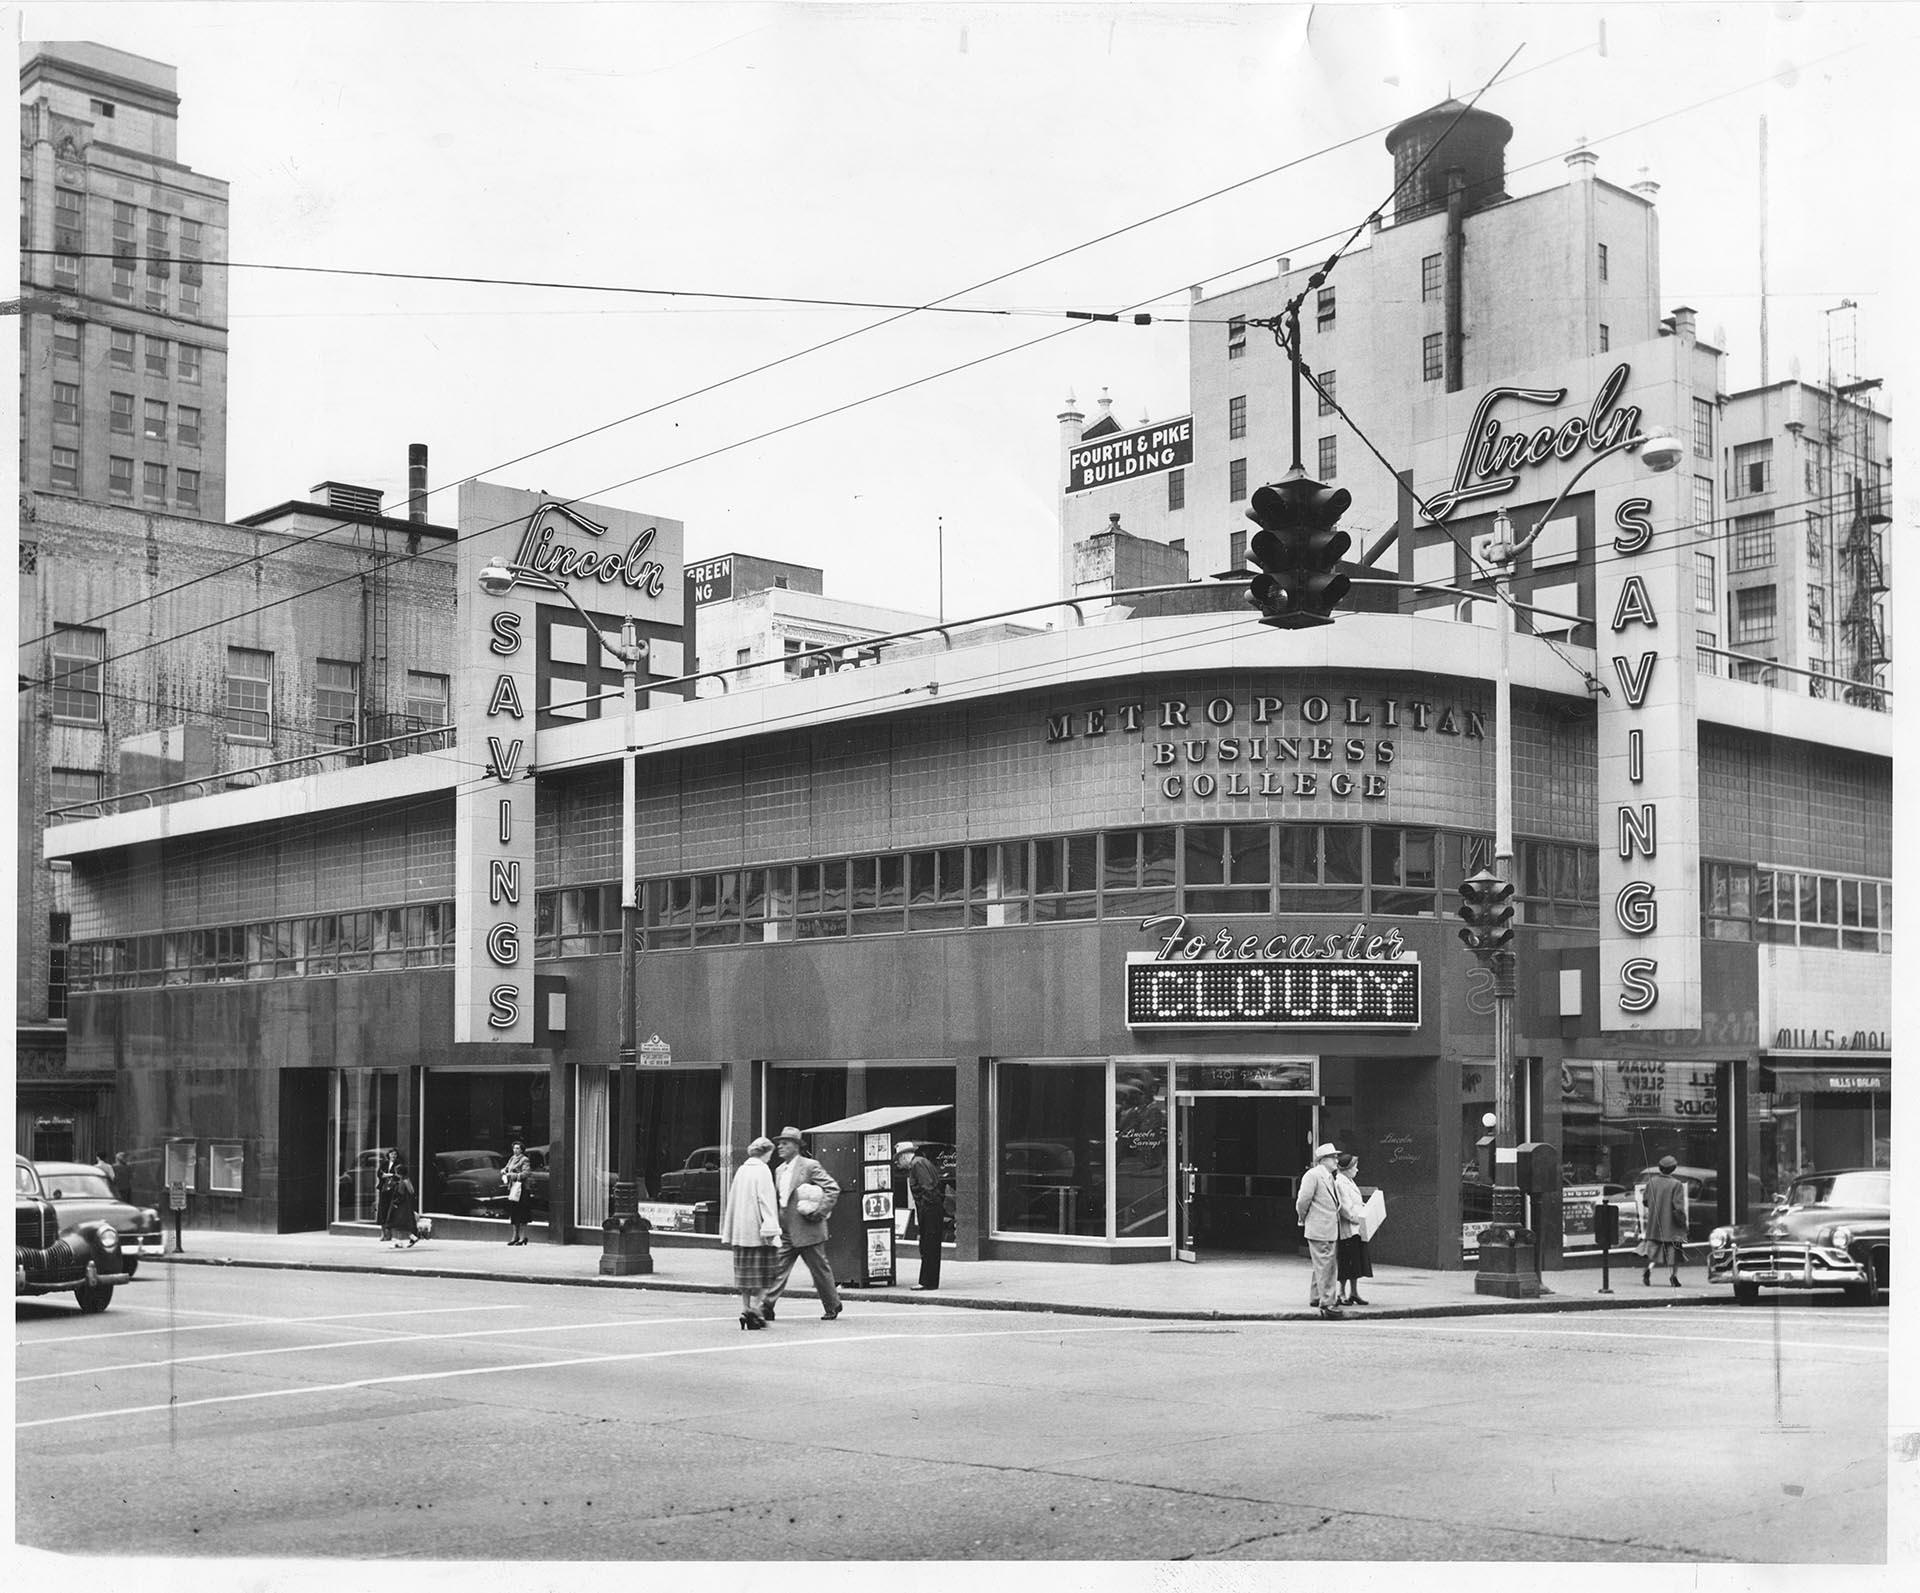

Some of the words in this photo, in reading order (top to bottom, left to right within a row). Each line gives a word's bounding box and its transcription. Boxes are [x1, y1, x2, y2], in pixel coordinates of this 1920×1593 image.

[1071, 439, 1133, 471] FOURTH
[1136, 435, 1148, 453] &
[1152, 423, 1190, 449] PIKE
[1083, 447, 1176, 486] BUILDING
[1419, 362, 1643, 523] Lincoln
[503, 501, 665, 598] Lincoln
[1045, 695, 1488, 744] METROPOLITAN
[1153, 736, 1398, 766] BUSINESS
[1610, 497, 1660, 1014] SAVINGS
[1160, 772, 1389, 799] COLLEGE
[486, 611, 524, 1030] SAVINGS
[1139, 914, 1406, 961] Forecaster
[1151, 969, 1410, 1017] CLOUDY
[1121, 1129, 1156, 1138] Lincoln
